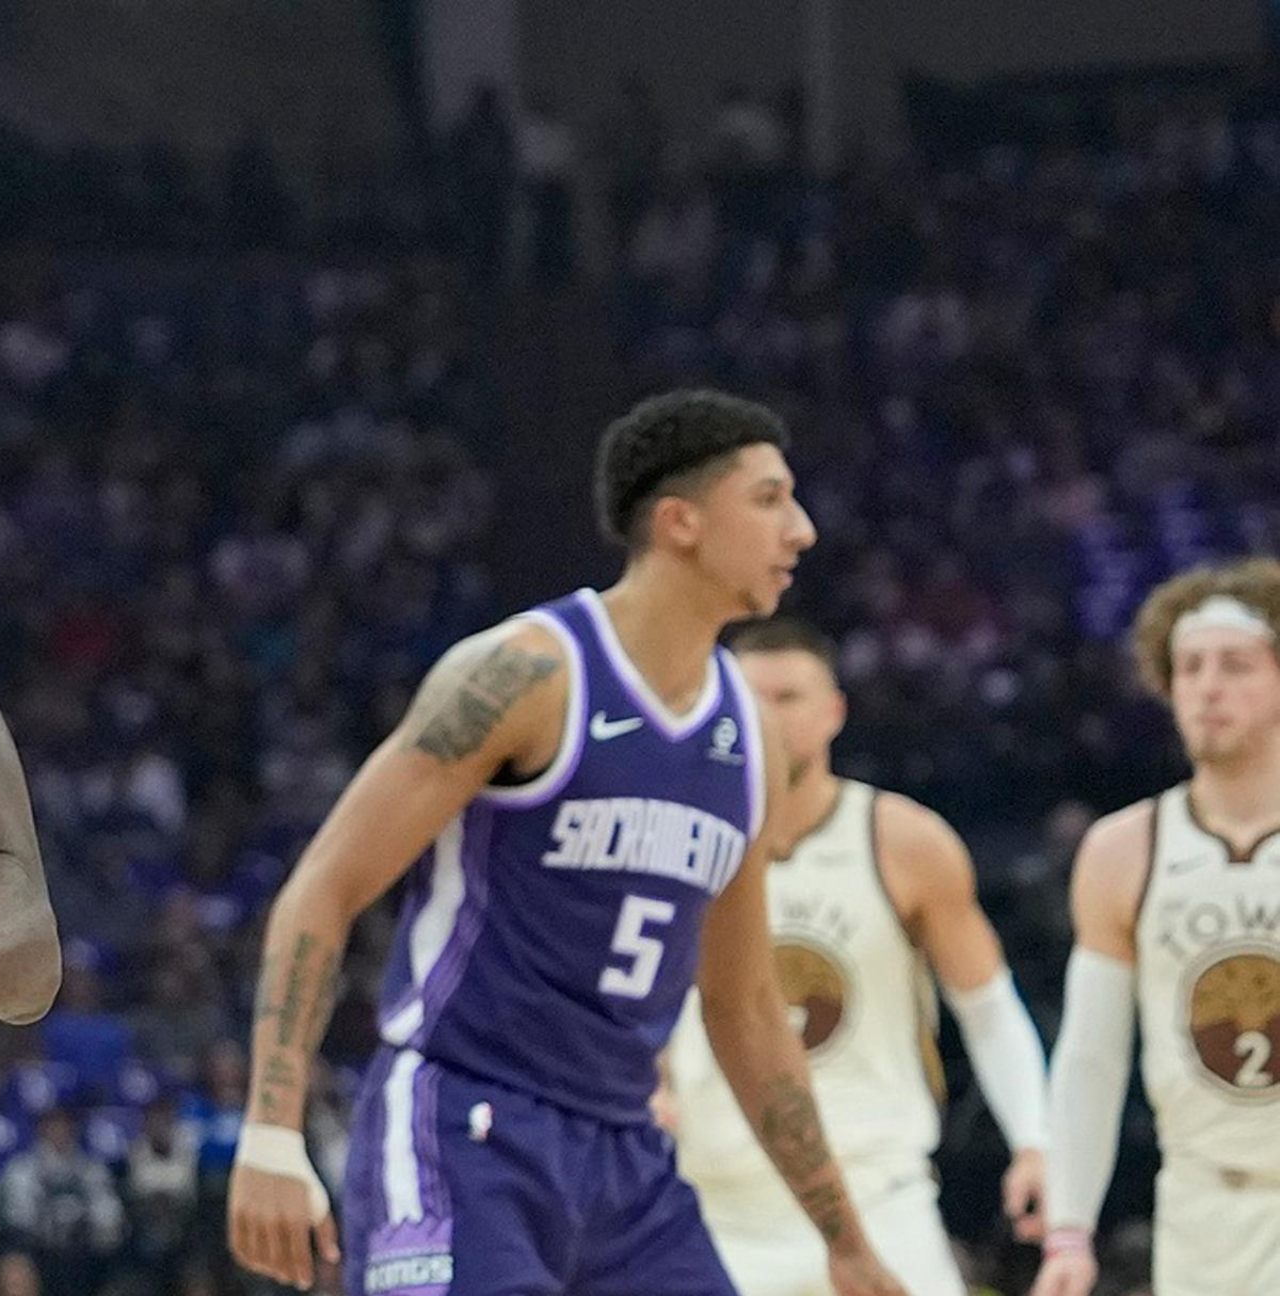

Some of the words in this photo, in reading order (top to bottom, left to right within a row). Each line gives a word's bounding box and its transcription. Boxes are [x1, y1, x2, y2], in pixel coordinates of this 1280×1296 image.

[598, 893, 676, 999] 5
[1159, 892, 1280, 960] TOW
[1233, 1030, 1273, 1087] 2
